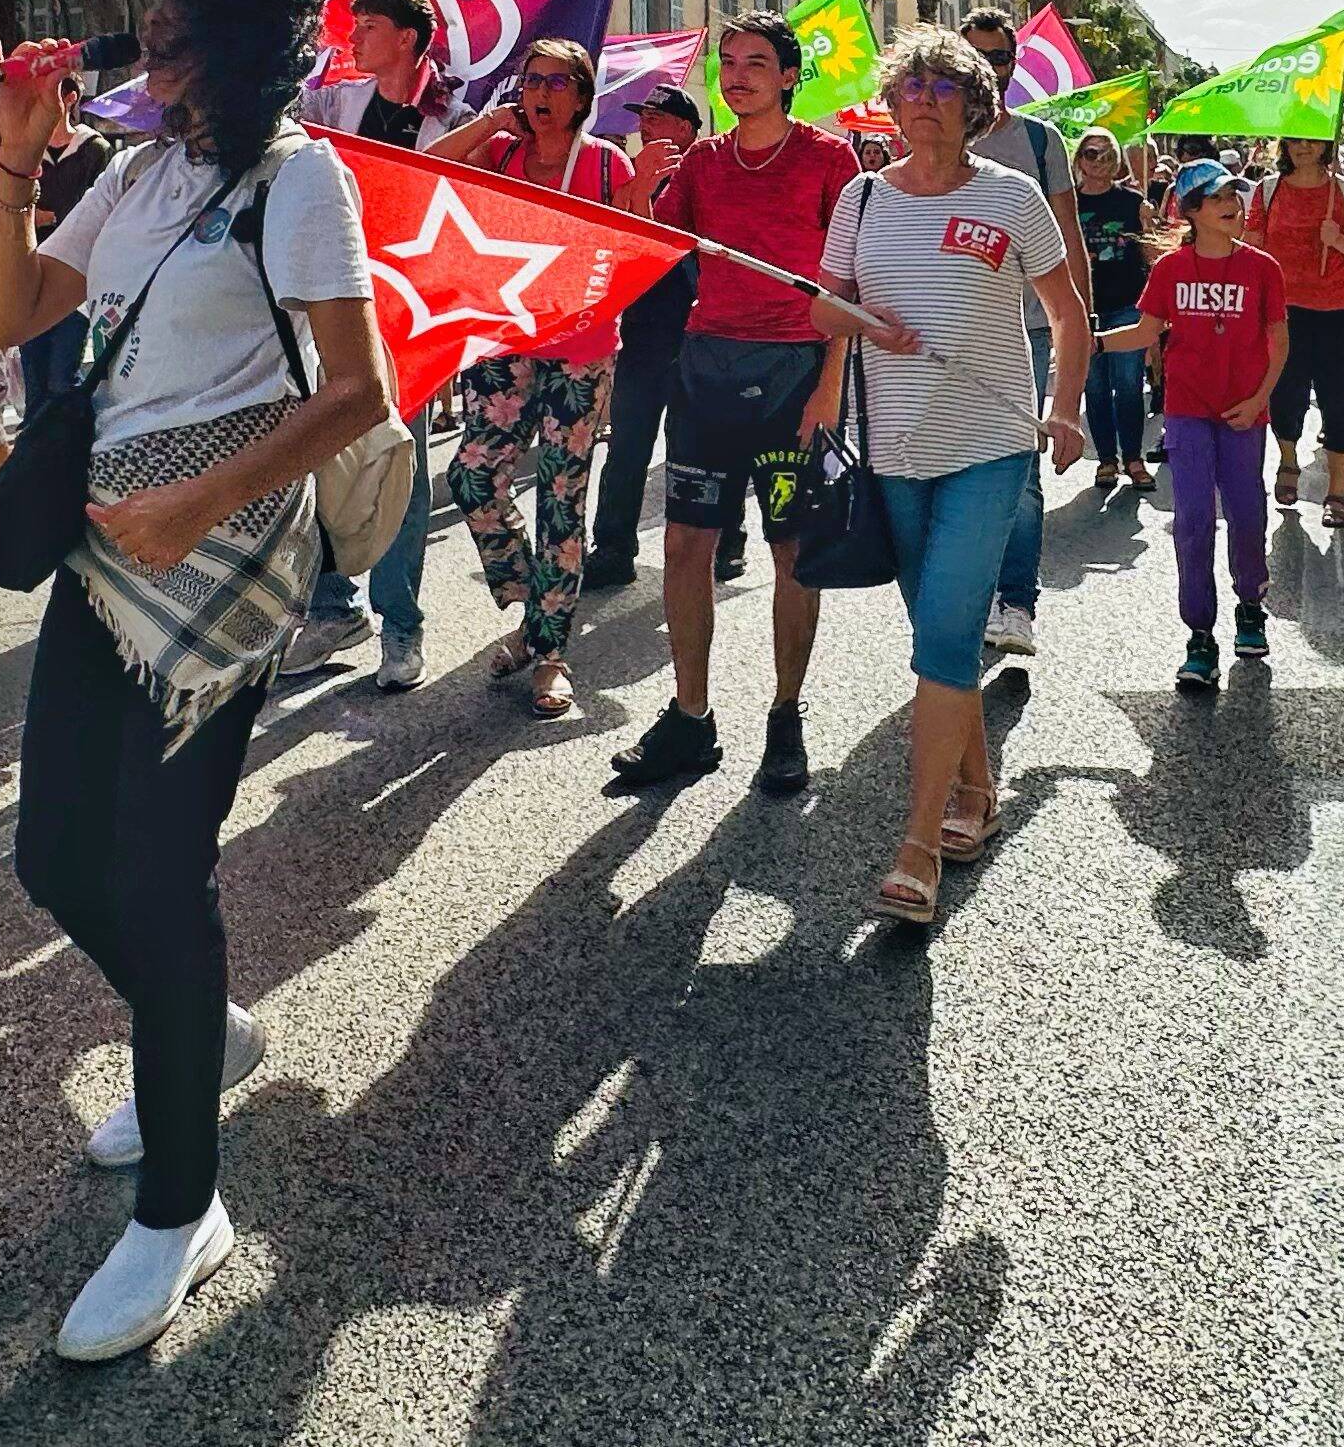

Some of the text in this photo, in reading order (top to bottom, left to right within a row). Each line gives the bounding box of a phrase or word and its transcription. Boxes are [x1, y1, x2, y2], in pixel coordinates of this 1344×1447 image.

[954, 221, 1002, 247] PCF
[101, 293, 125, 307] FOR
[1176, 283, 1244, 312] DIESEL
